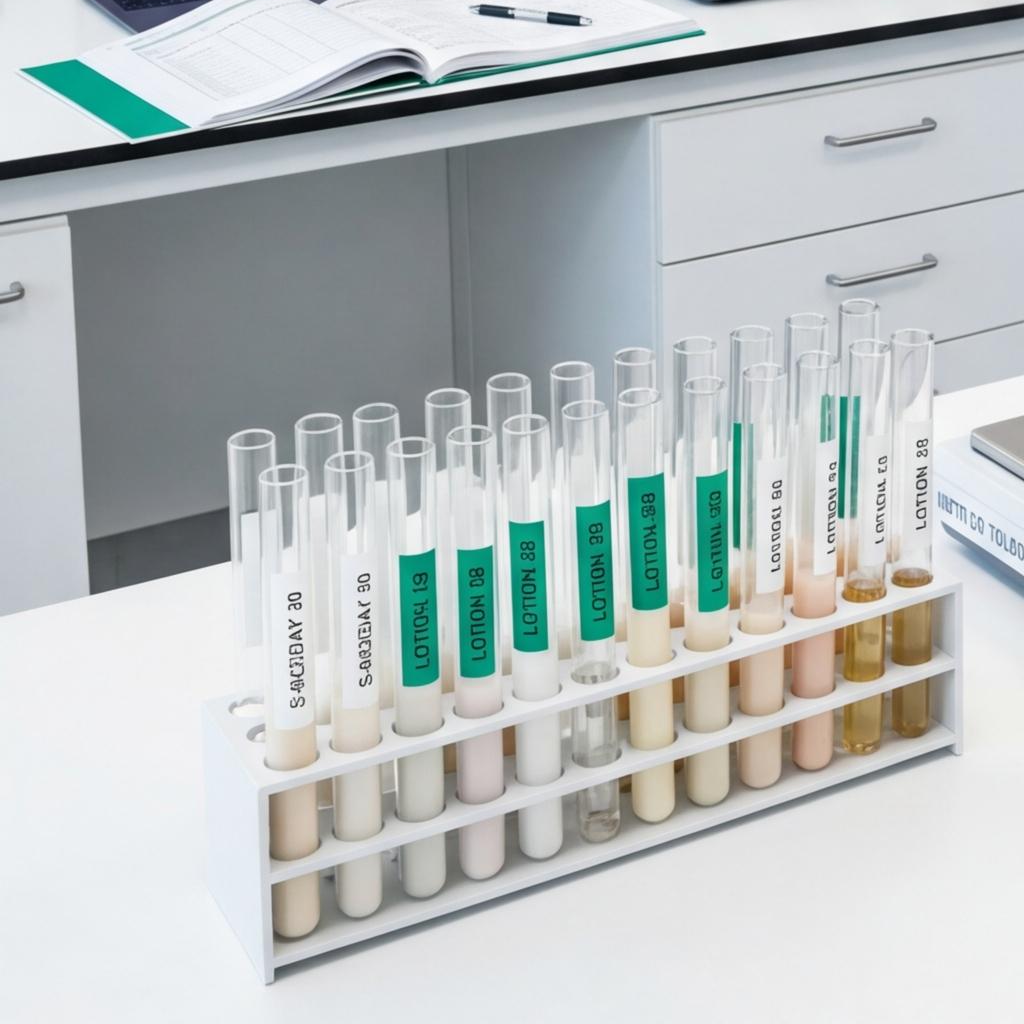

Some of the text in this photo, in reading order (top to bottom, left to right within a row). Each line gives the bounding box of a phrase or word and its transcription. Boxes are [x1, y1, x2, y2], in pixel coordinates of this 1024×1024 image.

[521, 568, 538, 636] LOTION
[589, 553, 606, 622] LOTION
[470, 595, 487, 661] LOTION
